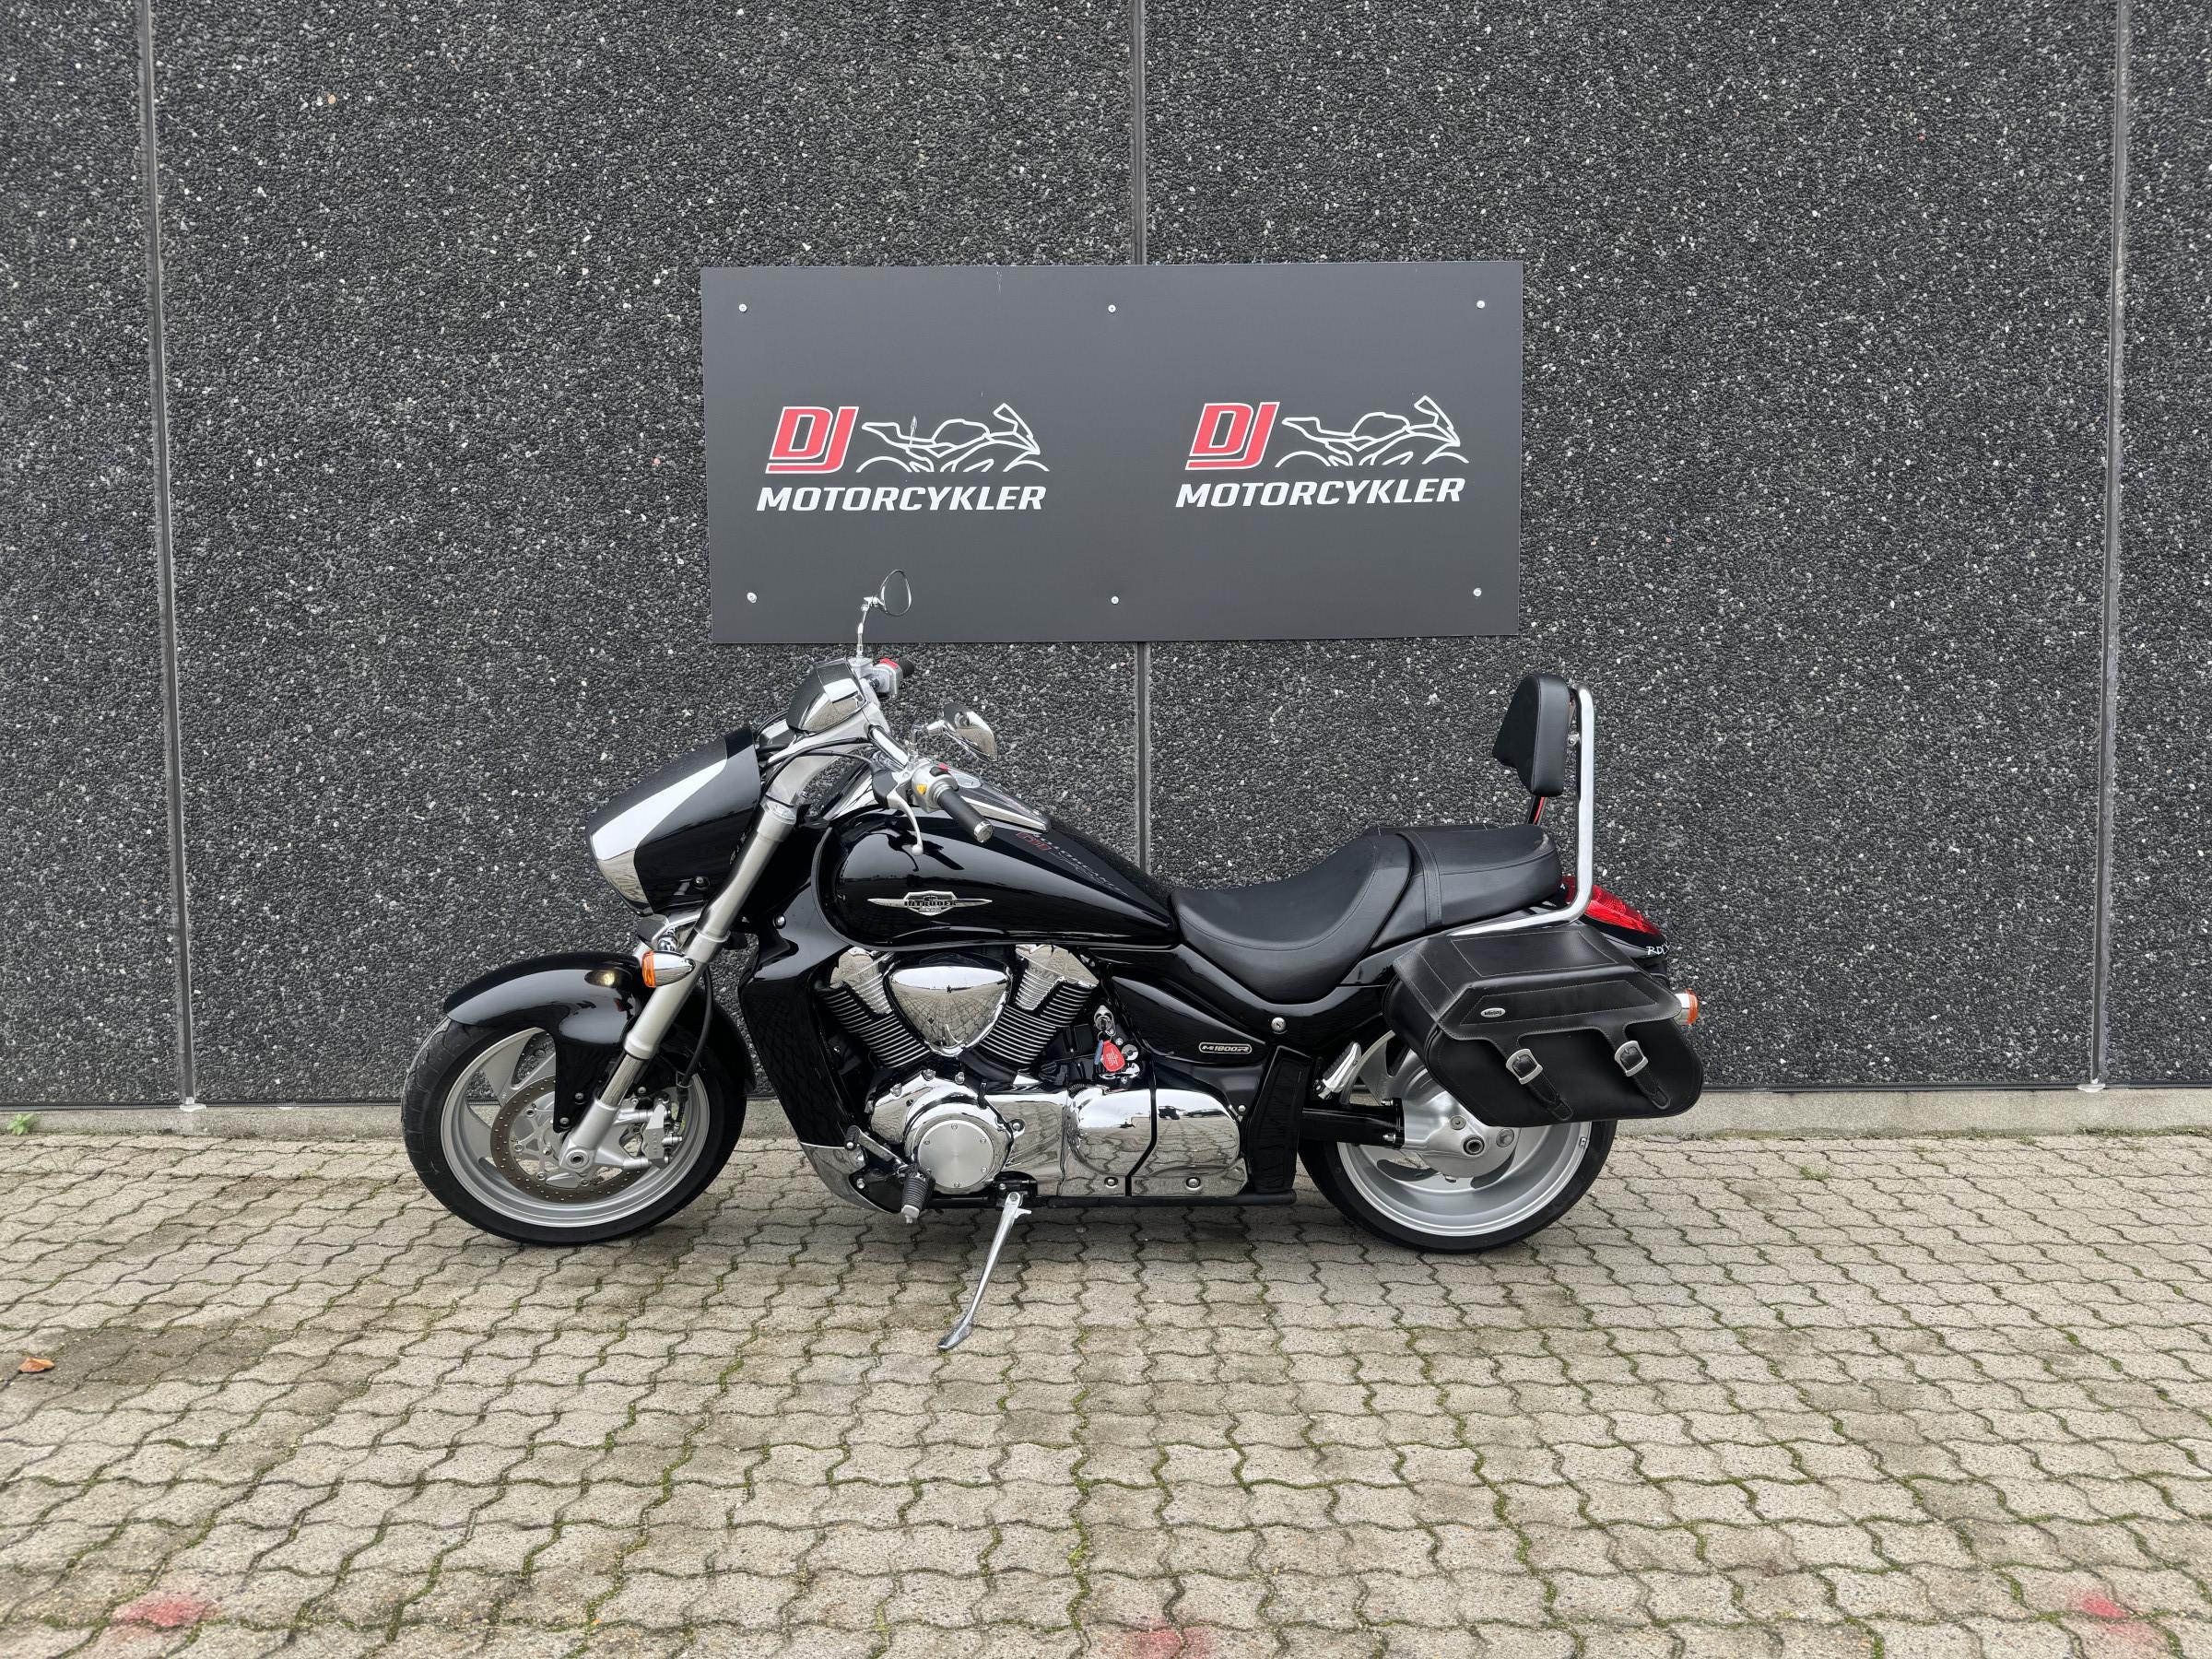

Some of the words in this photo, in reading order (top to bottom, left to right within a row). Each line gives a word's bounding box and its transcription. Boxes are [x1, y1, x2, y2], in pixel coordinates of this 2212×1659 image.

[765, 406, 860, 475] DJ
[1185, 401, 1280, 471] DJ
[756, 485, 1048, 512] MOTORCYKLER
[1175, 477, 1466, 508] MOTORCYKLER
[1201, 1044, 1250, 1053] M1800R
